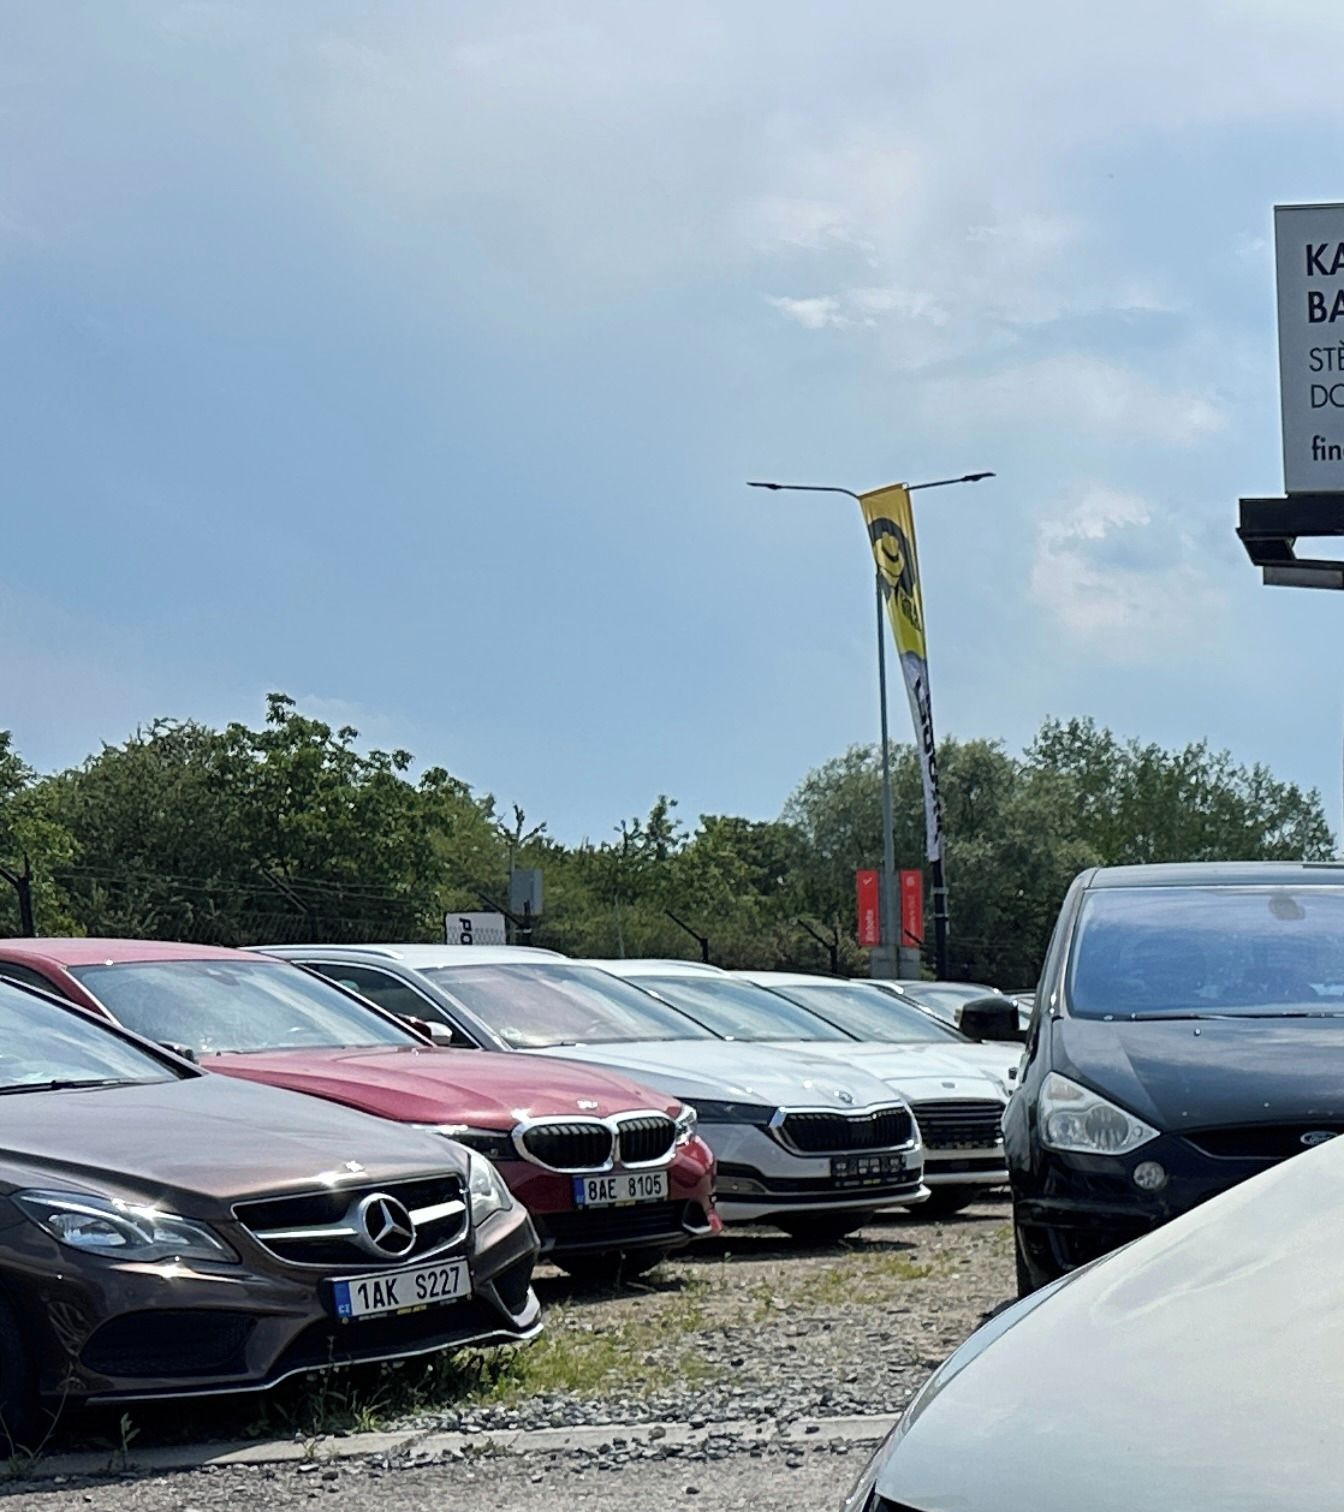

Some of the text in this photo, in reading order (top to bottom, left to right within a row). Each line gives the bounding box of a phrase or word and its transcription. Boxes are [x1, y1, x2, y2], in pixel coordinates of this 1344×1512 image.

[588, 1179, 617, 1200] 8AE
[628, 1175, 662, 1197] 8105
[358, 1266, 460, 1310] 1AK S227
